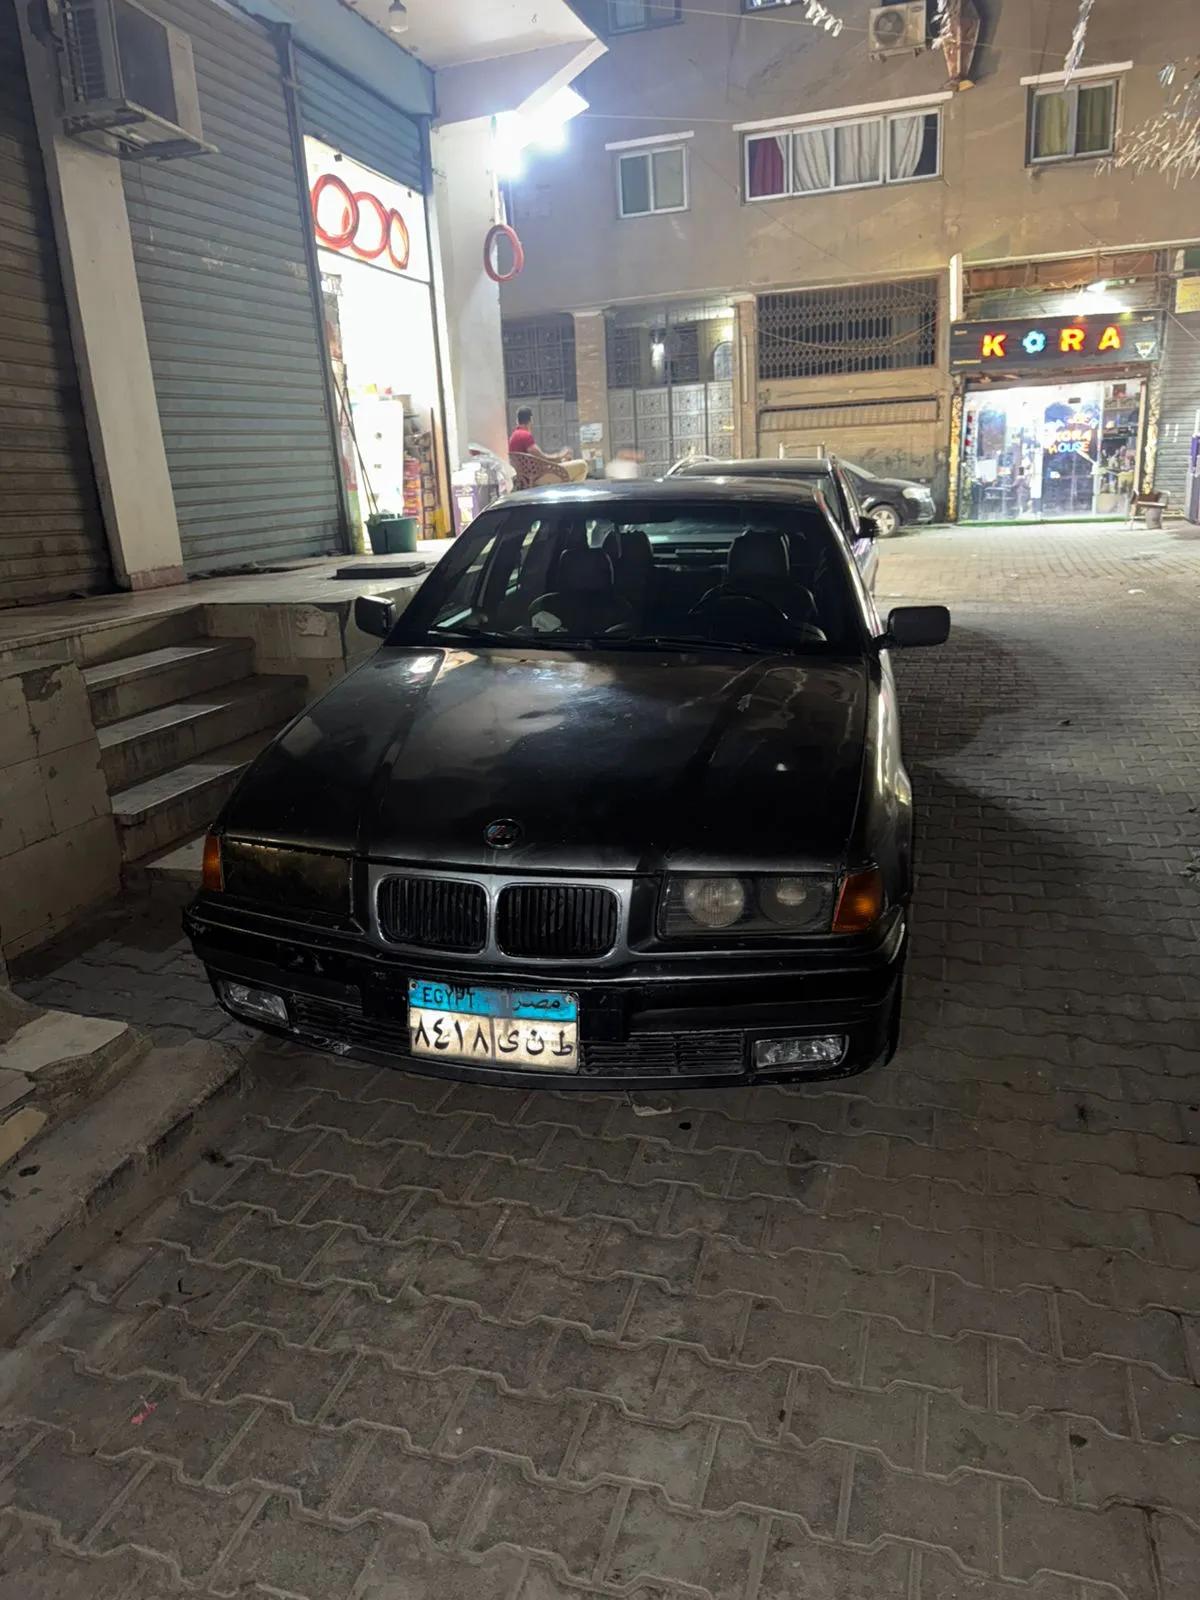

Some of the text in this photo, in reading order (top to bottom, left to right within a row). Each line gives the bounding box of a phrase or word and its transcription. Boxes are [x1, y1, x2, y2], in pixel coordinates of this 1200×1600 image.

[981, 326, 1122, 357] KORA
[513, 998, 561, 1011] مصر
[415, 1015, 489, 1053] ٨٤١٨
